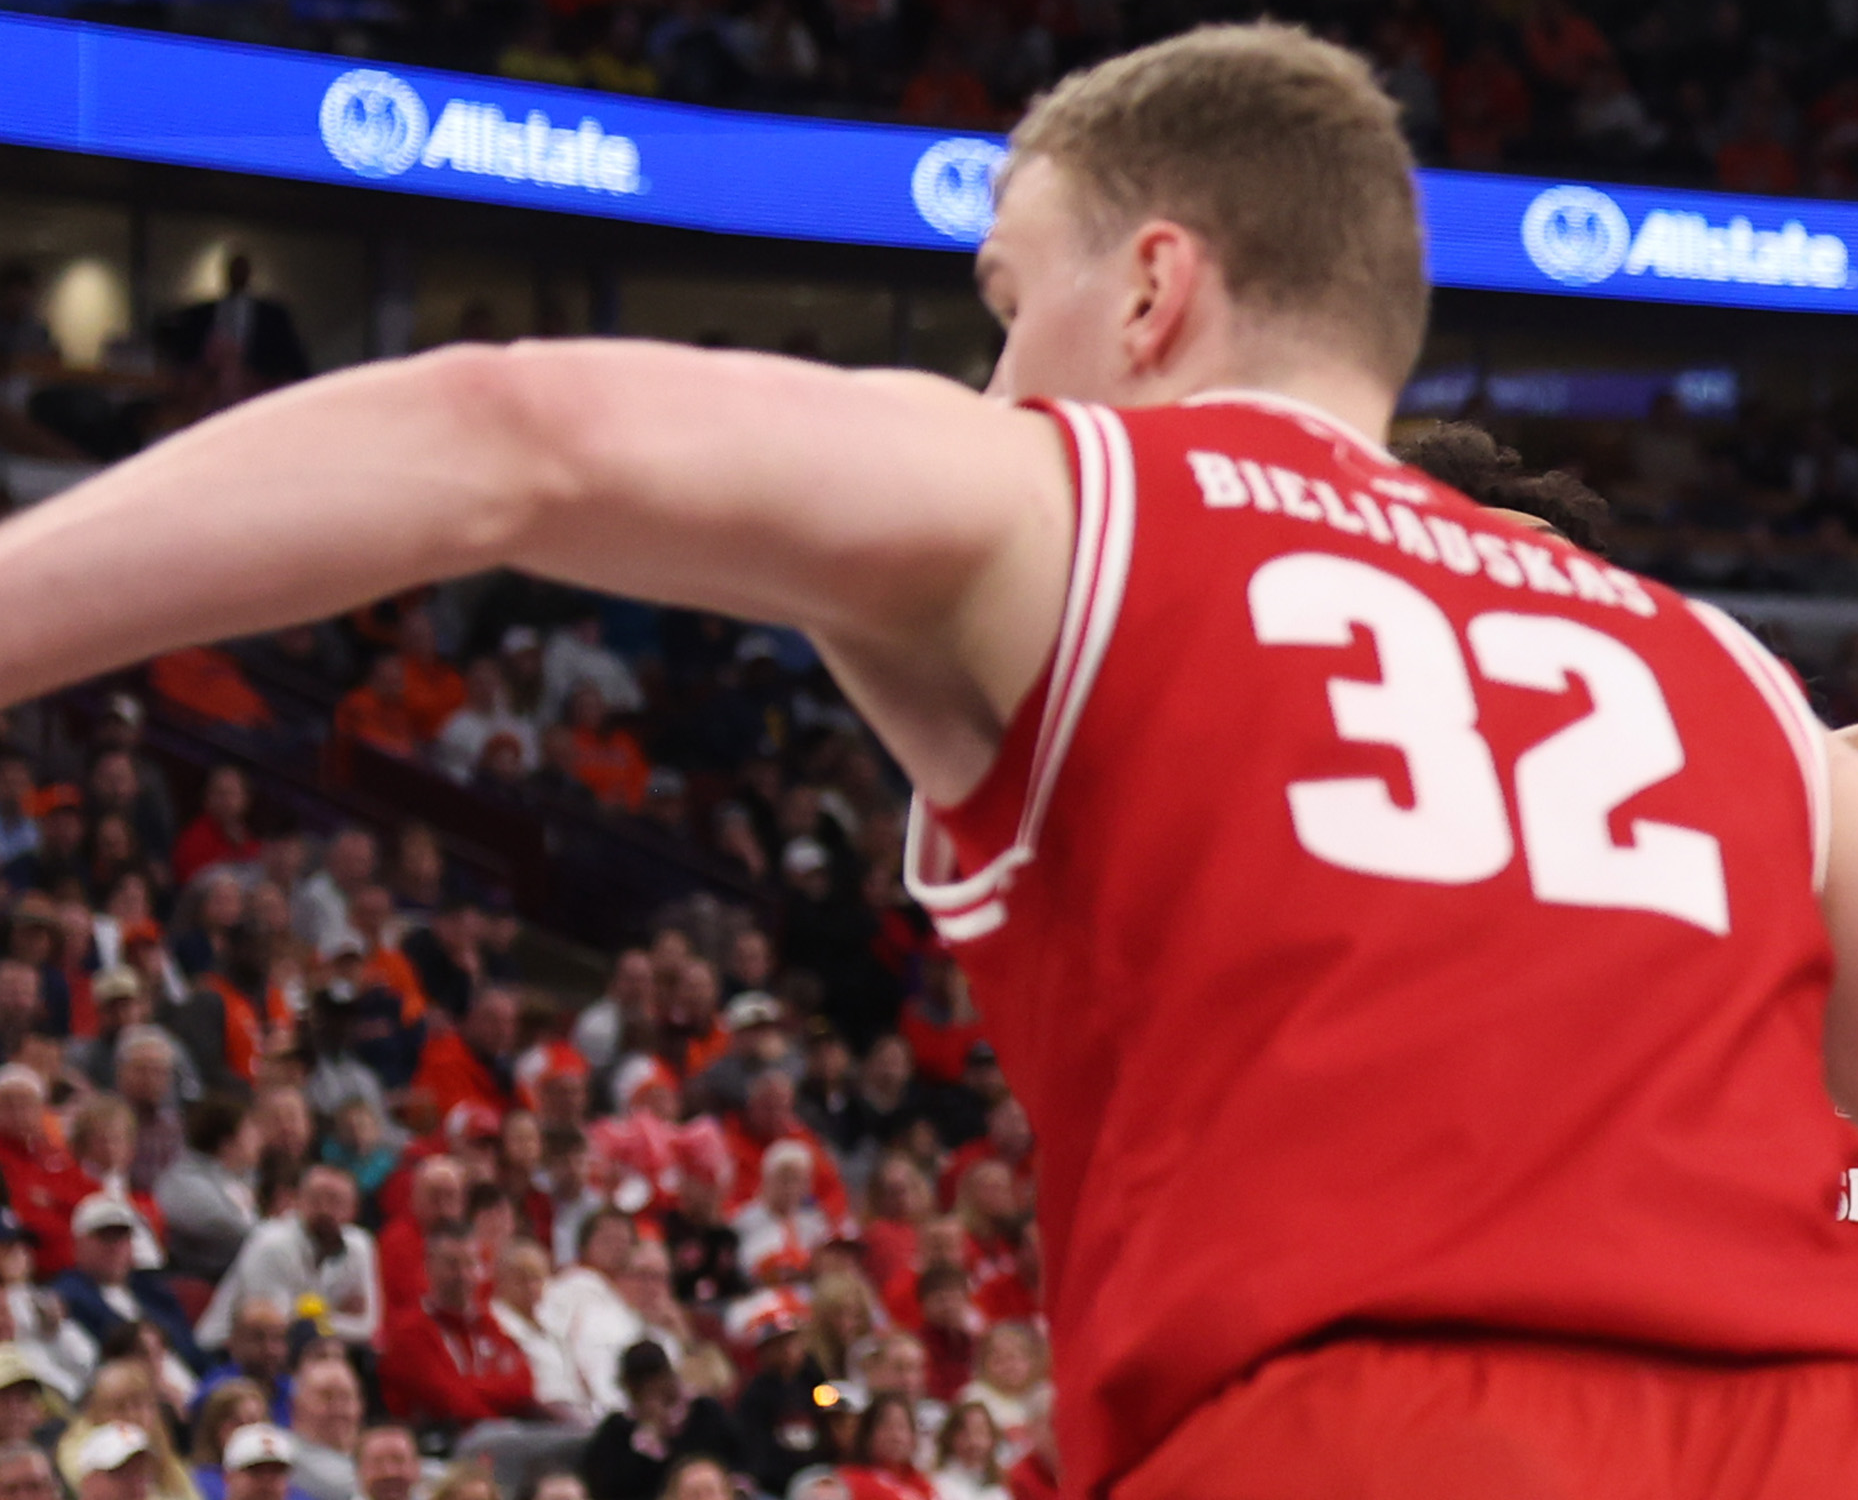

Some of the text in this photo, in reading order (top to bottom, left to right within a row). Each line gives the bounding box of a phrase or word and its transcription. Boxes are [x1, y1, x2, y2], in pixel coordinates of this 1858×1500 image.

[422, 98, 642, 196] Allstate
[1625, 208, 1850, 290] Allstate
[1187, 450, 1657, 618] BIELIAUSKAS
[1247, 551, 1731, 937] 32
